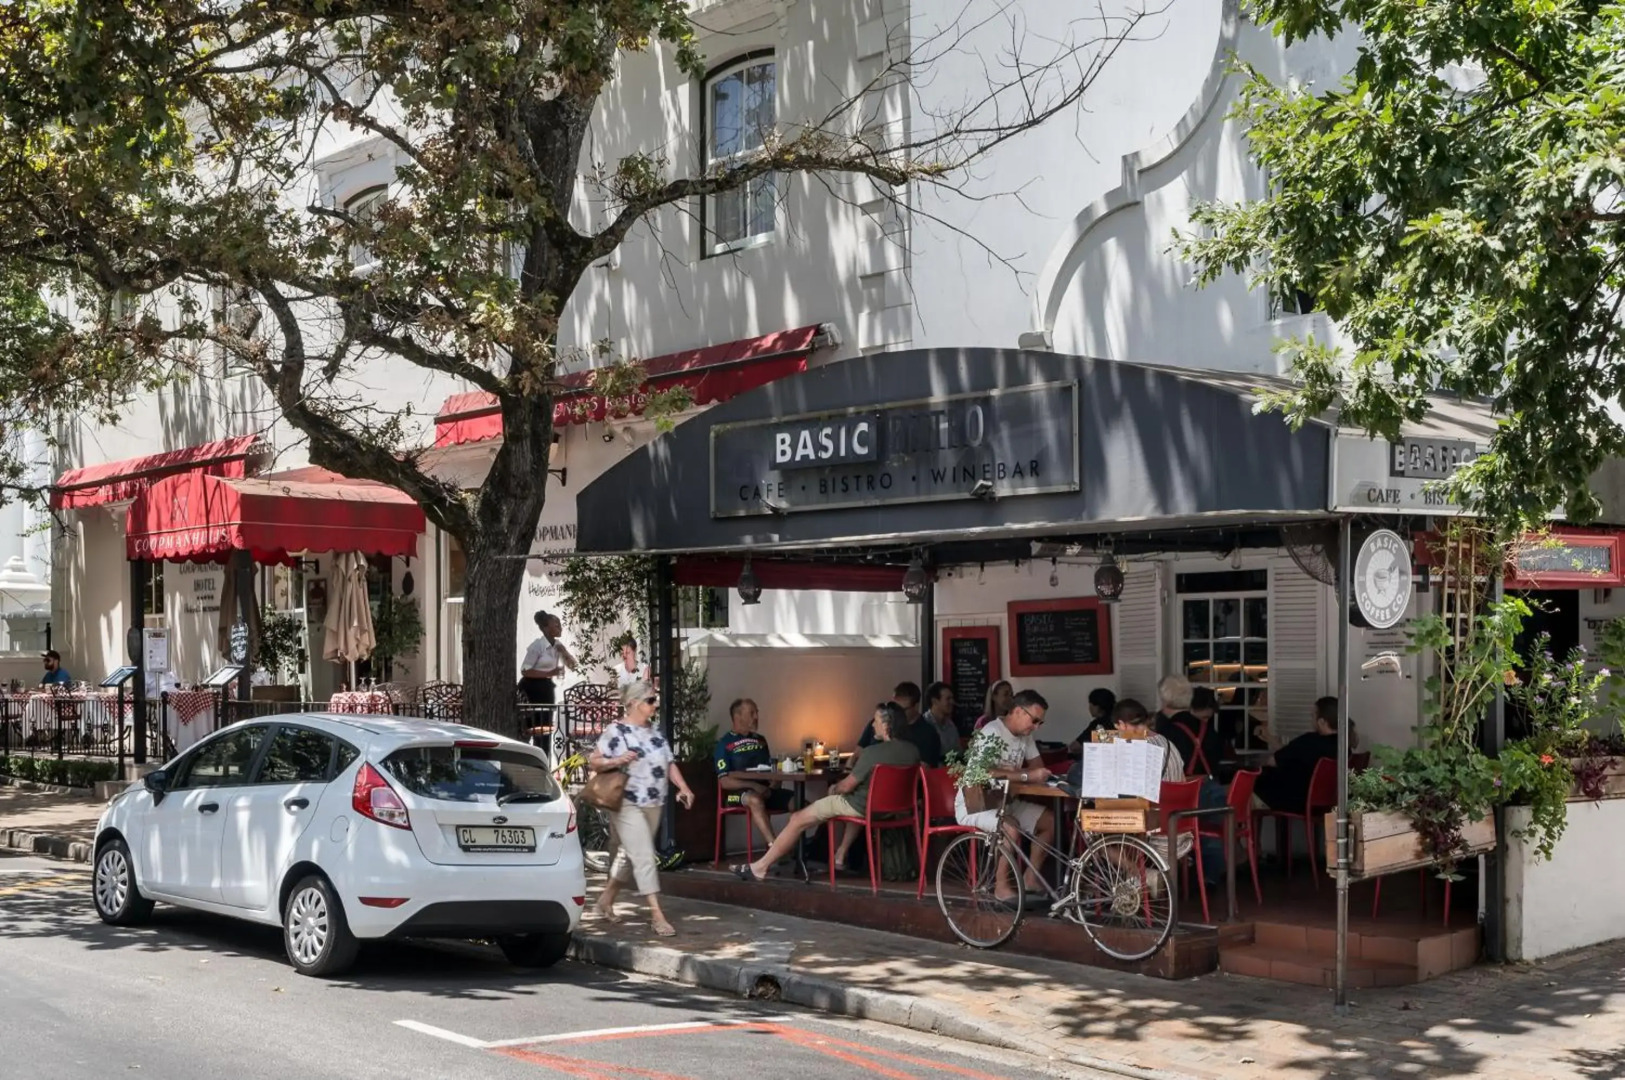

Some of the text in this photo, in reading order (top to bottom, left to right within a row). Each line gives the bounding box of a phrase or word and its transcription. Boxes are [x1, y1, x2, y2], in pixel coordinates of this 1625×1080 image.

[775, 422, 869, 464] BASIC
[739, 460, 1040, 500] CAFE BISTRO WINEBAR
[1367, 488, 1401, 504] CAFE
[134, 528, 229, 552] COOPMANHUIJS
[1370, 536, 1398, 553] BASIC
[193, 578, 215, 591] HOTEL
[1361, 592, 1391, 621] COFFEE
[462, 829, 526, 845] CL 76303
